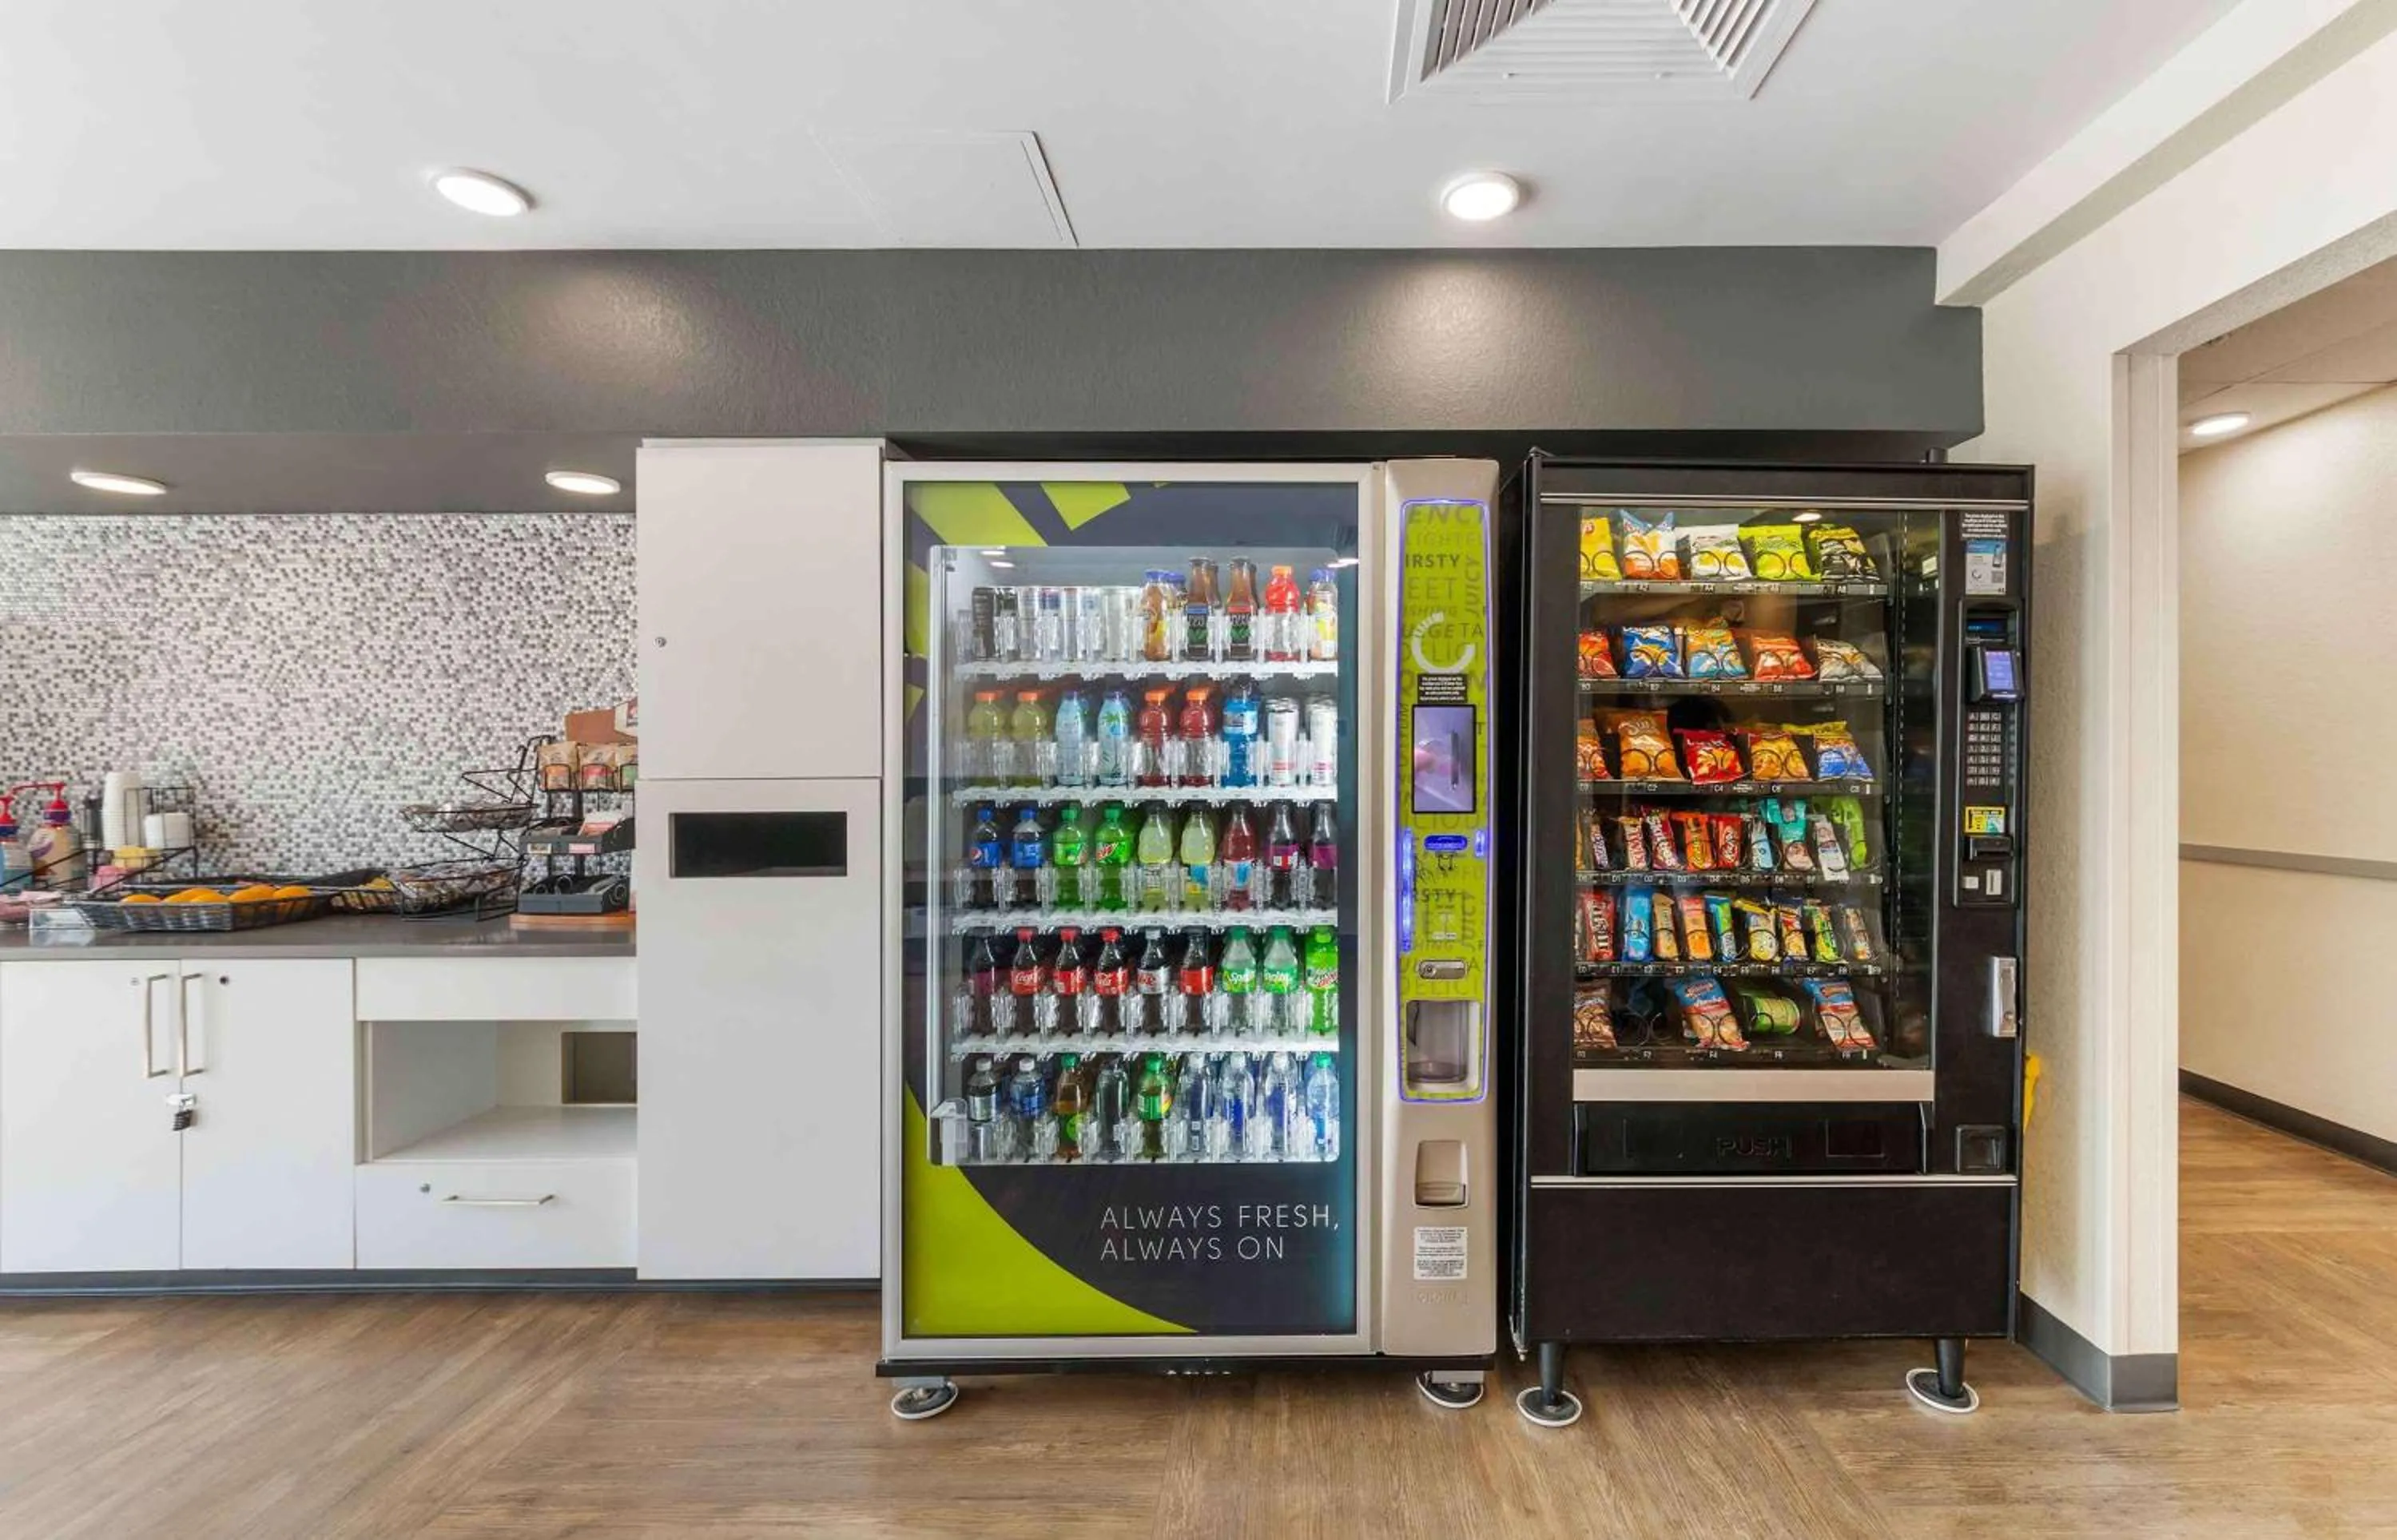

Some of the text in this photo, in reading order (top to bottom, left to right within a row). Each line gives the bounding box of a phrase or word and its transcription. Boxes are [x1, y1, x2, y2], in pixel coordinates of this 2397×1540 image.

[1716, 1136, 1791, 1157] PUSH
[1101, 1204, 1339, 1230] ALWAYS FRESH,
[1101, 1236, 1283, 1260] ALWAYS ON
